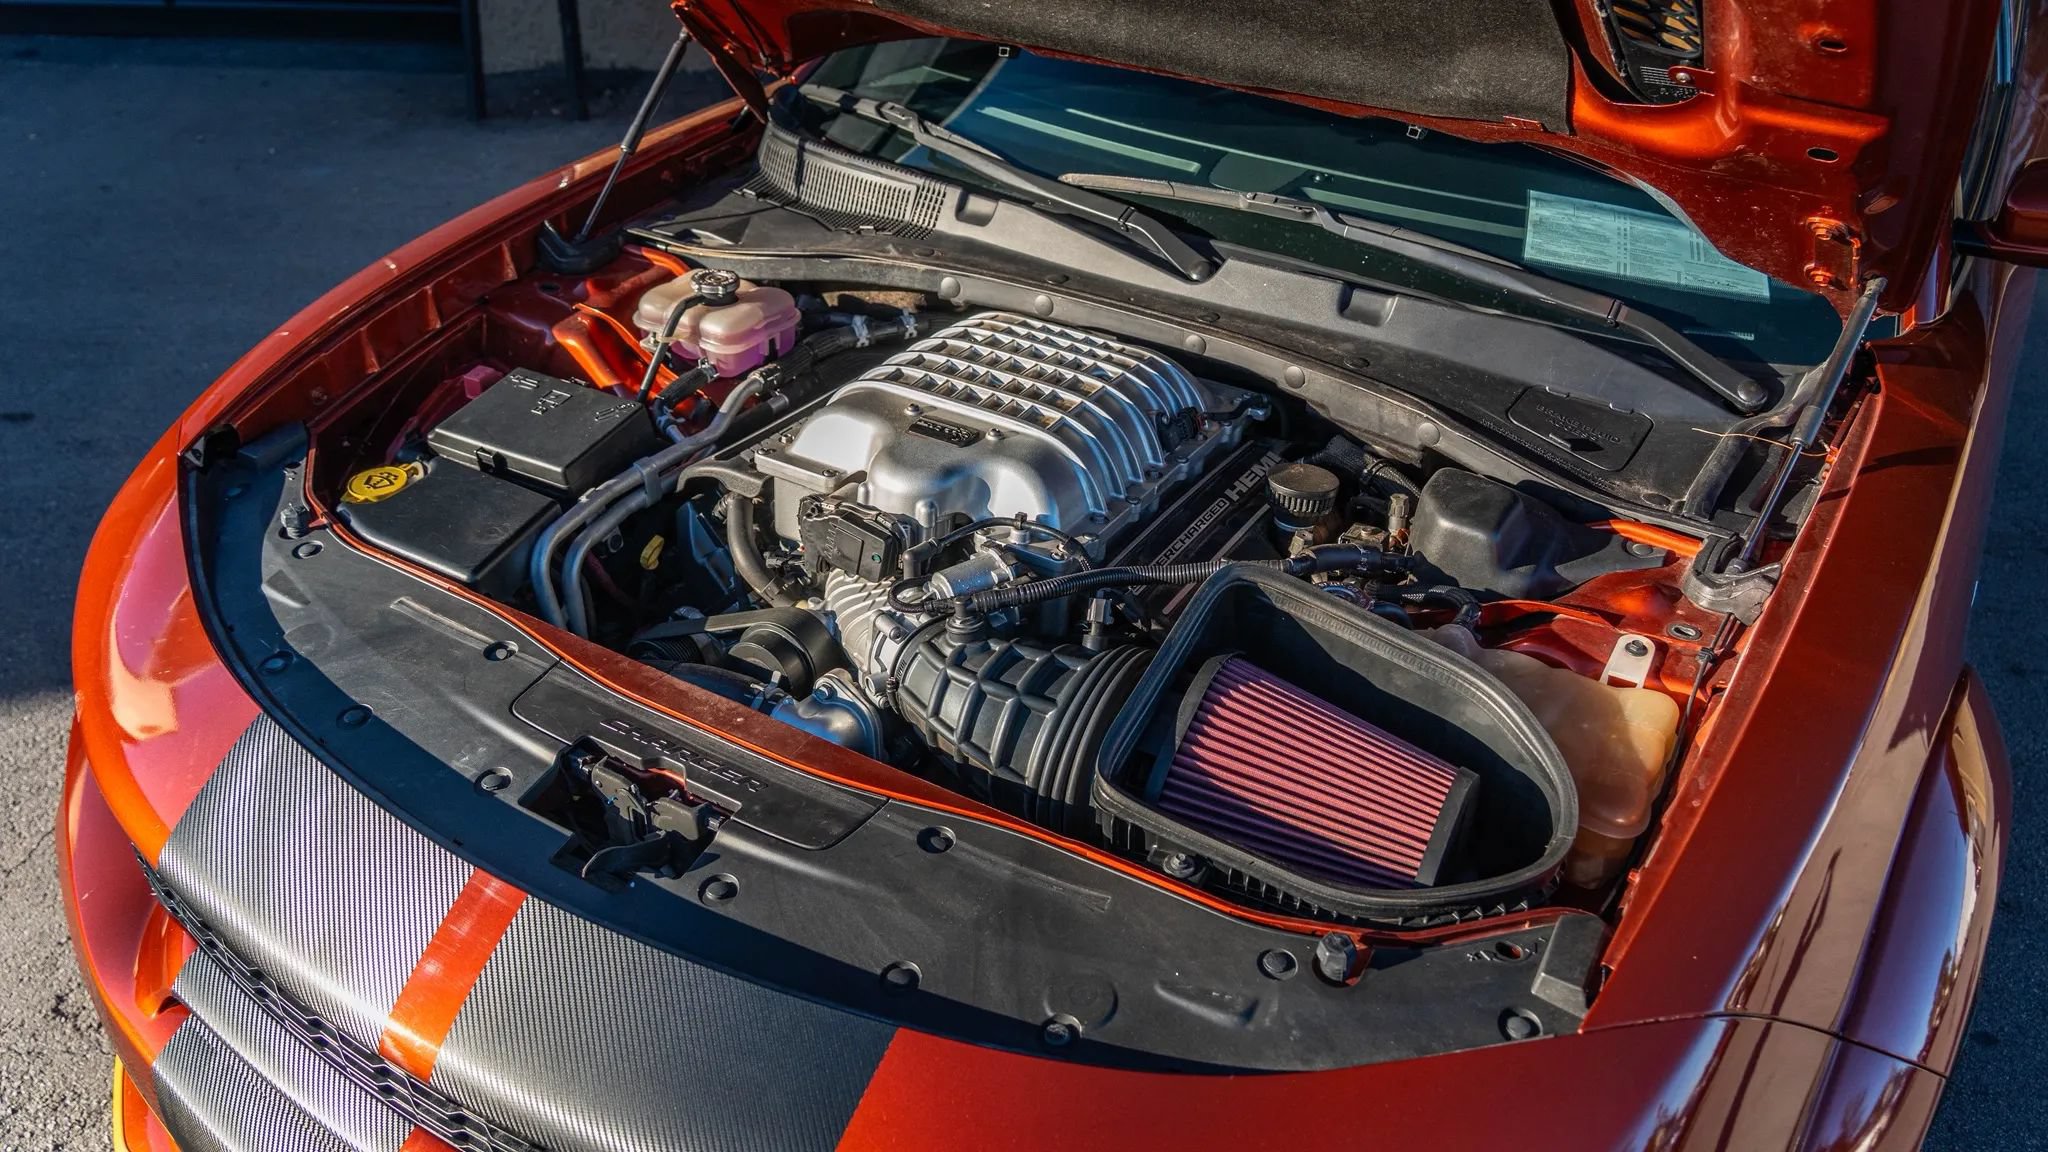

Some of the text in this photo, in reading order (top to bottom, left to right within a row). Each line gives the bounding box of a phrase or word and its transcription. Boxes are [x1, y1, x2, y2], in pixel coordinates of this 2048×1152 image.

[1132, 451, 1282, 594] ERCHARGED HEMI
[600, 719, 769, 793] CHARGER
